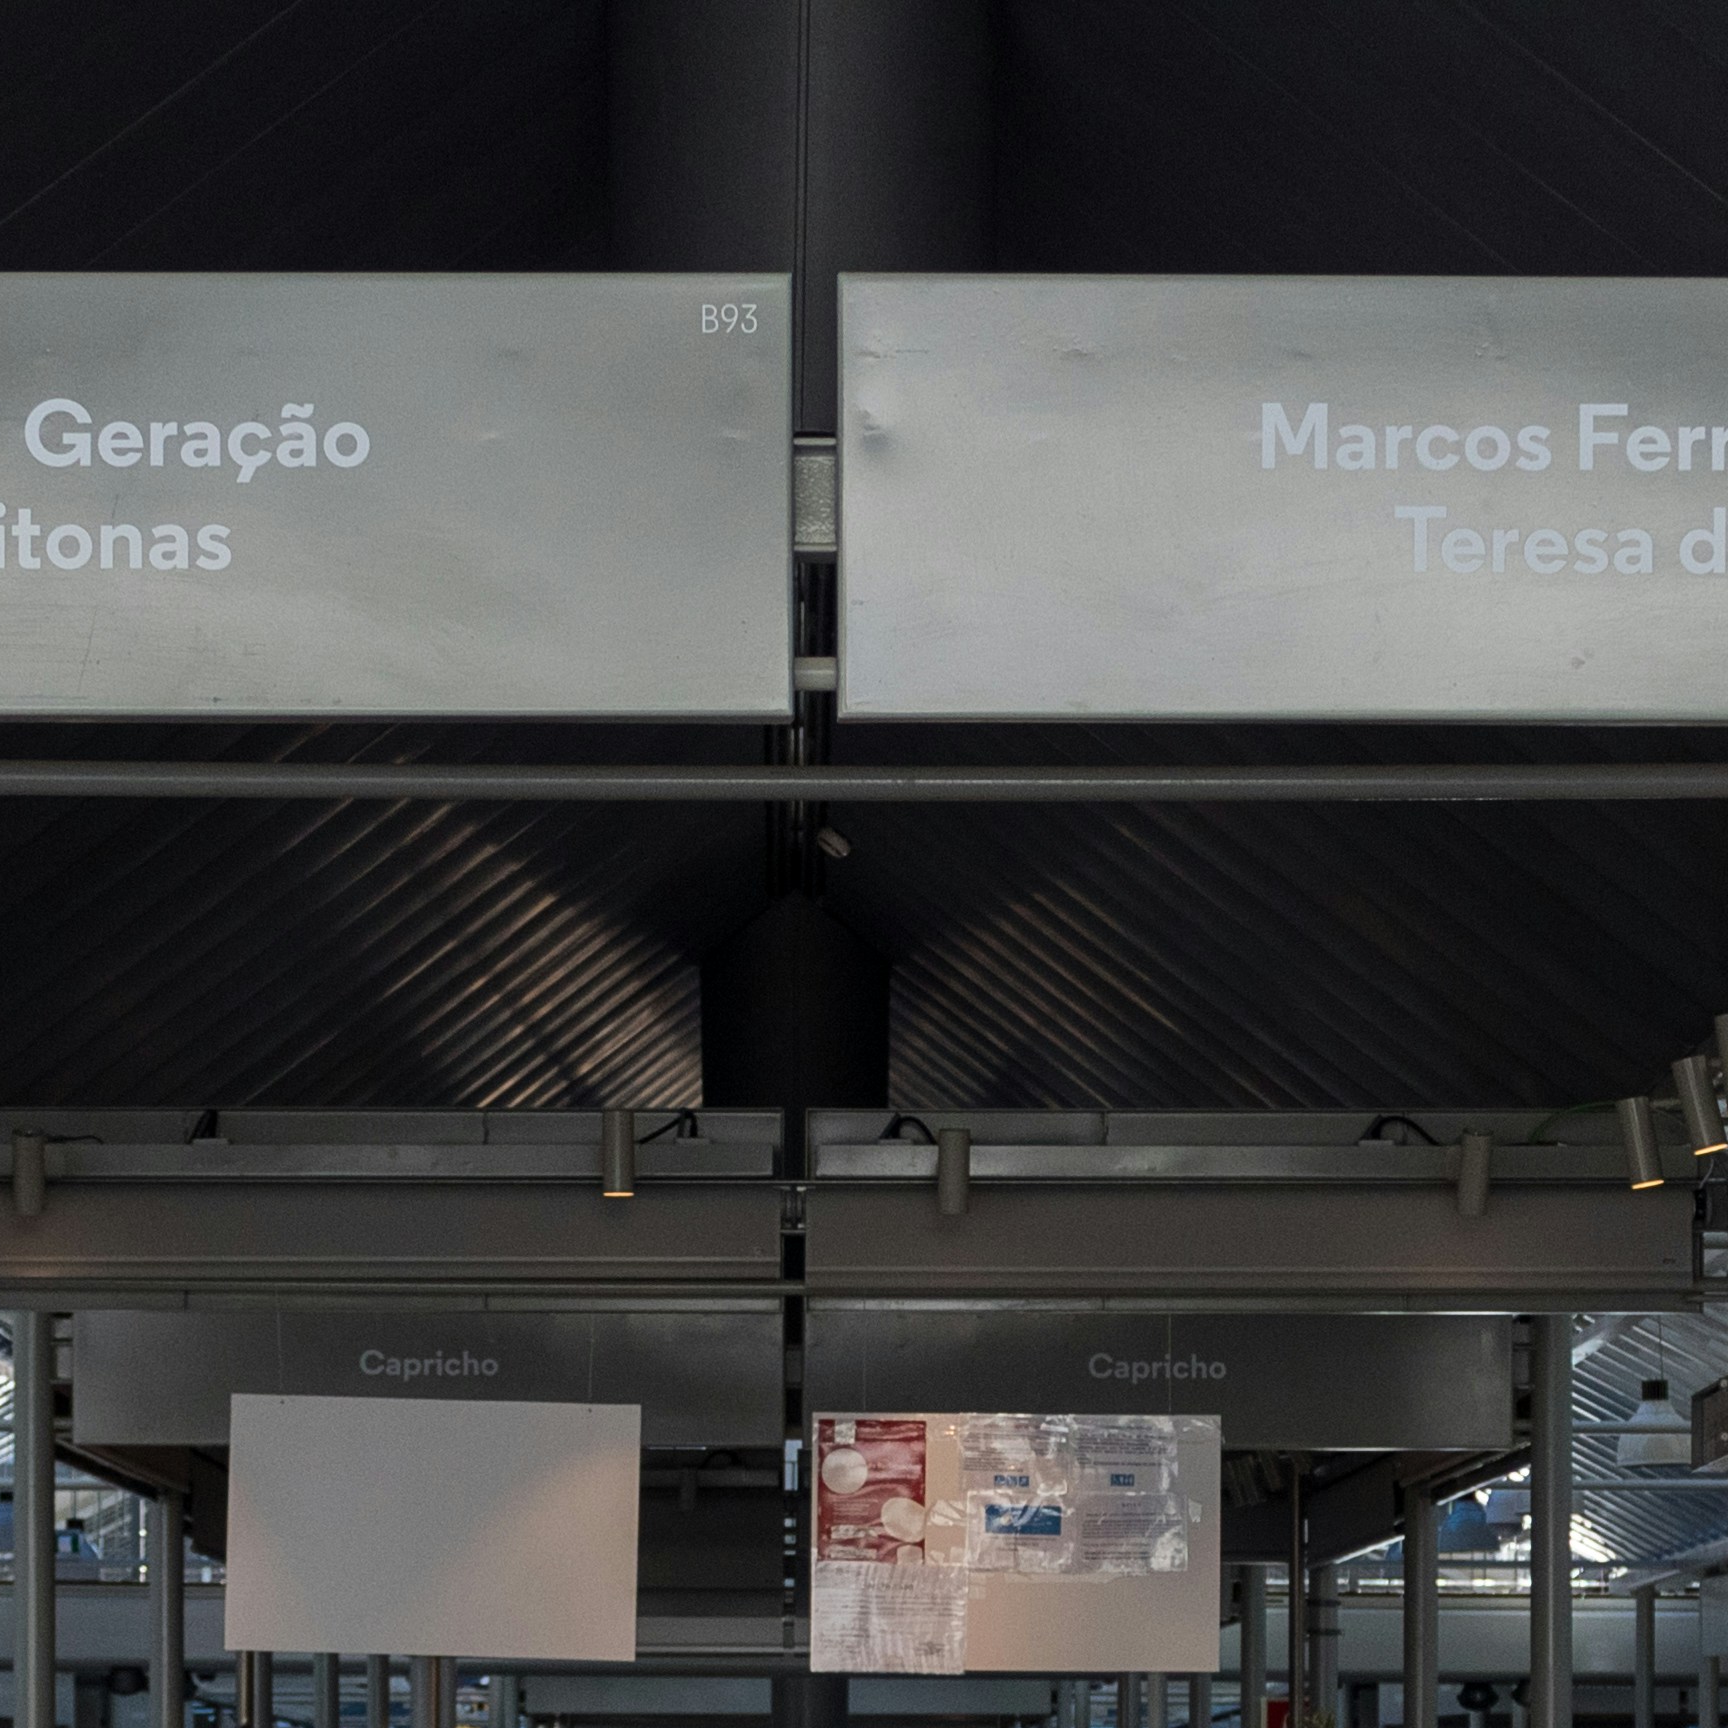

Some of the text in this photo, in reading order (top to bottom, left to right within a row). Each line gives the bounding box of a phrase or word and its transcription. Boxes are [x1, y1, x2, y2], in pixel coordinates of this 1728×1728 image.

[701, 303, 758, 334] B93
[23, 397, 370, 483] Geração
[1260, 402, 1551, 472] Marcos
[1396, 507, 1652, 575] Teresa
[359, 1349, 500, 1382] Capricho
[1087, 1352, 1228, 1386] Capricho
